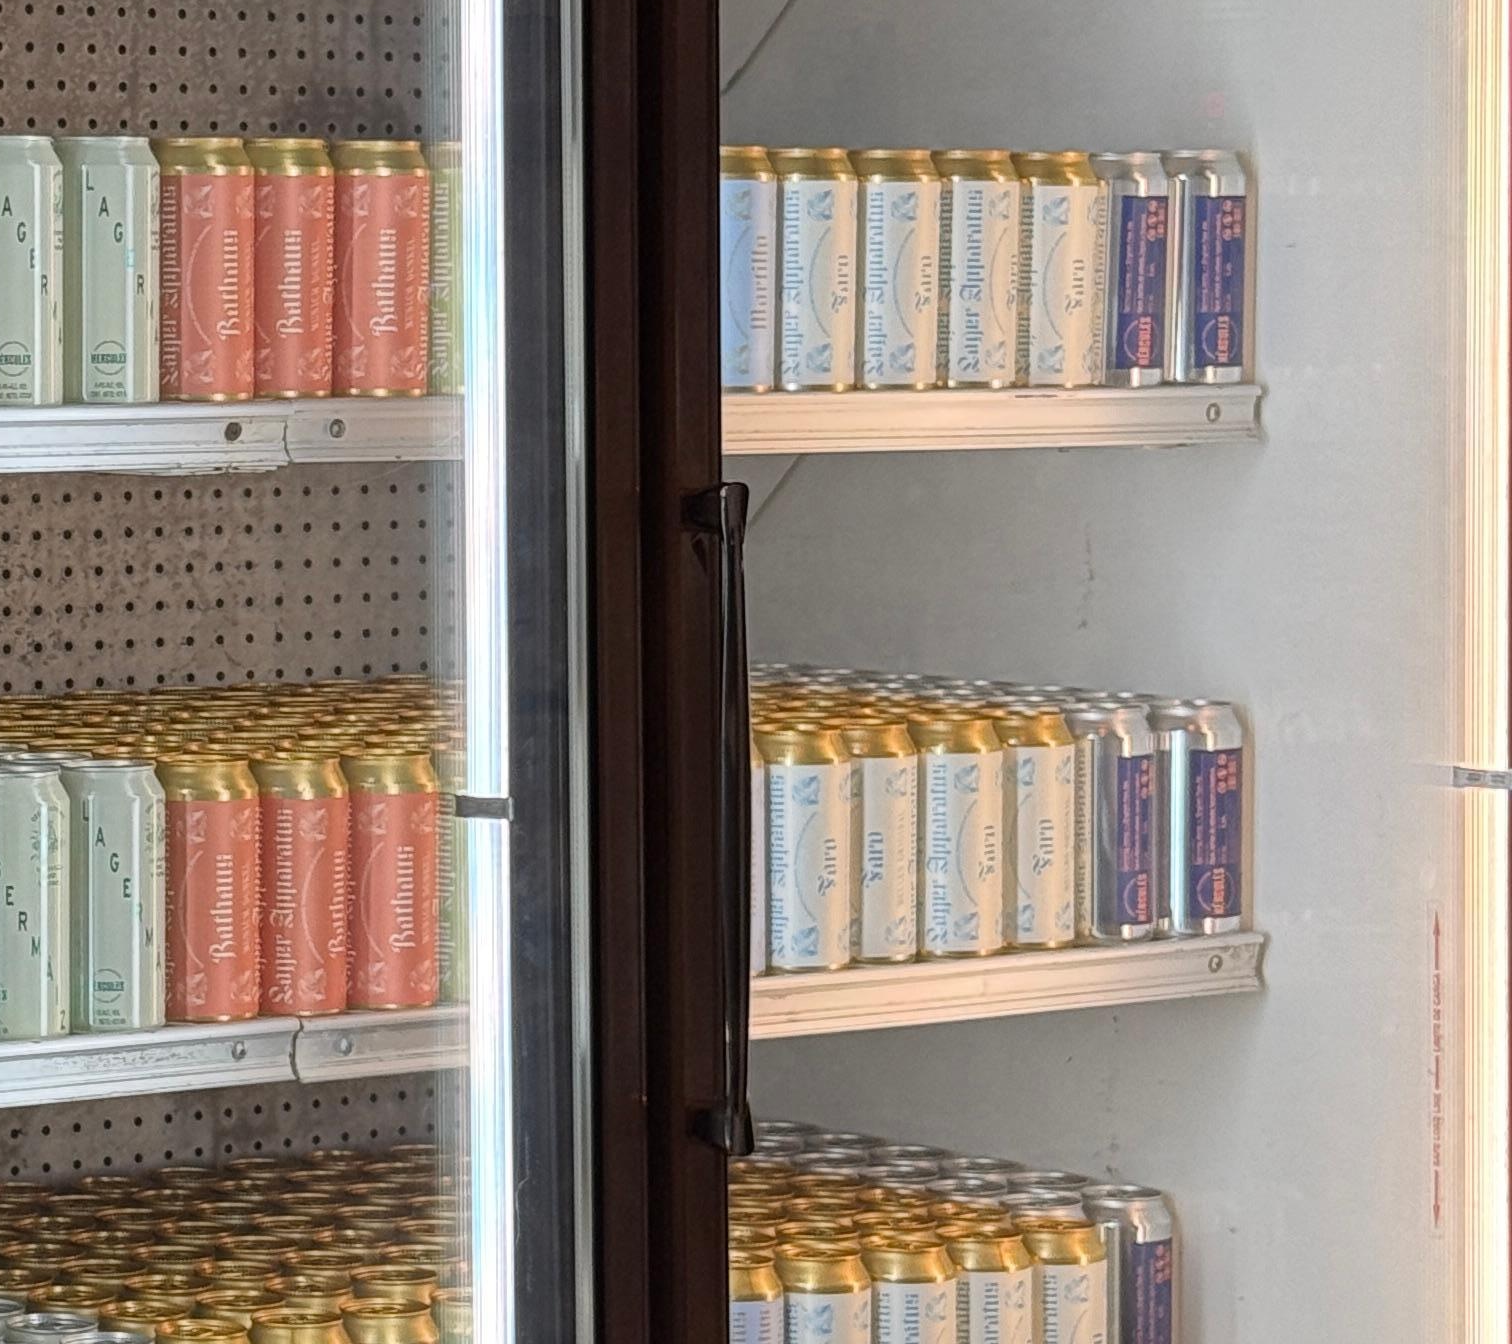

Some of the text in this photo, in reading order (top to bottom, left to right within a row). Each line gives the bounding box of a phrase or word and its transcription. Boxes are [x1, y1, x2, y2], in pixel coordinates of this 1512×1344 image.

[216, 229, 240, 341] Rathaus
[276, 229, 304, 340] Rathaus
[369, 228, 398, 337] Rathaus
[209, 854, 236, 964] Rathaus
[390, 844, 417, 954] Rathaus
